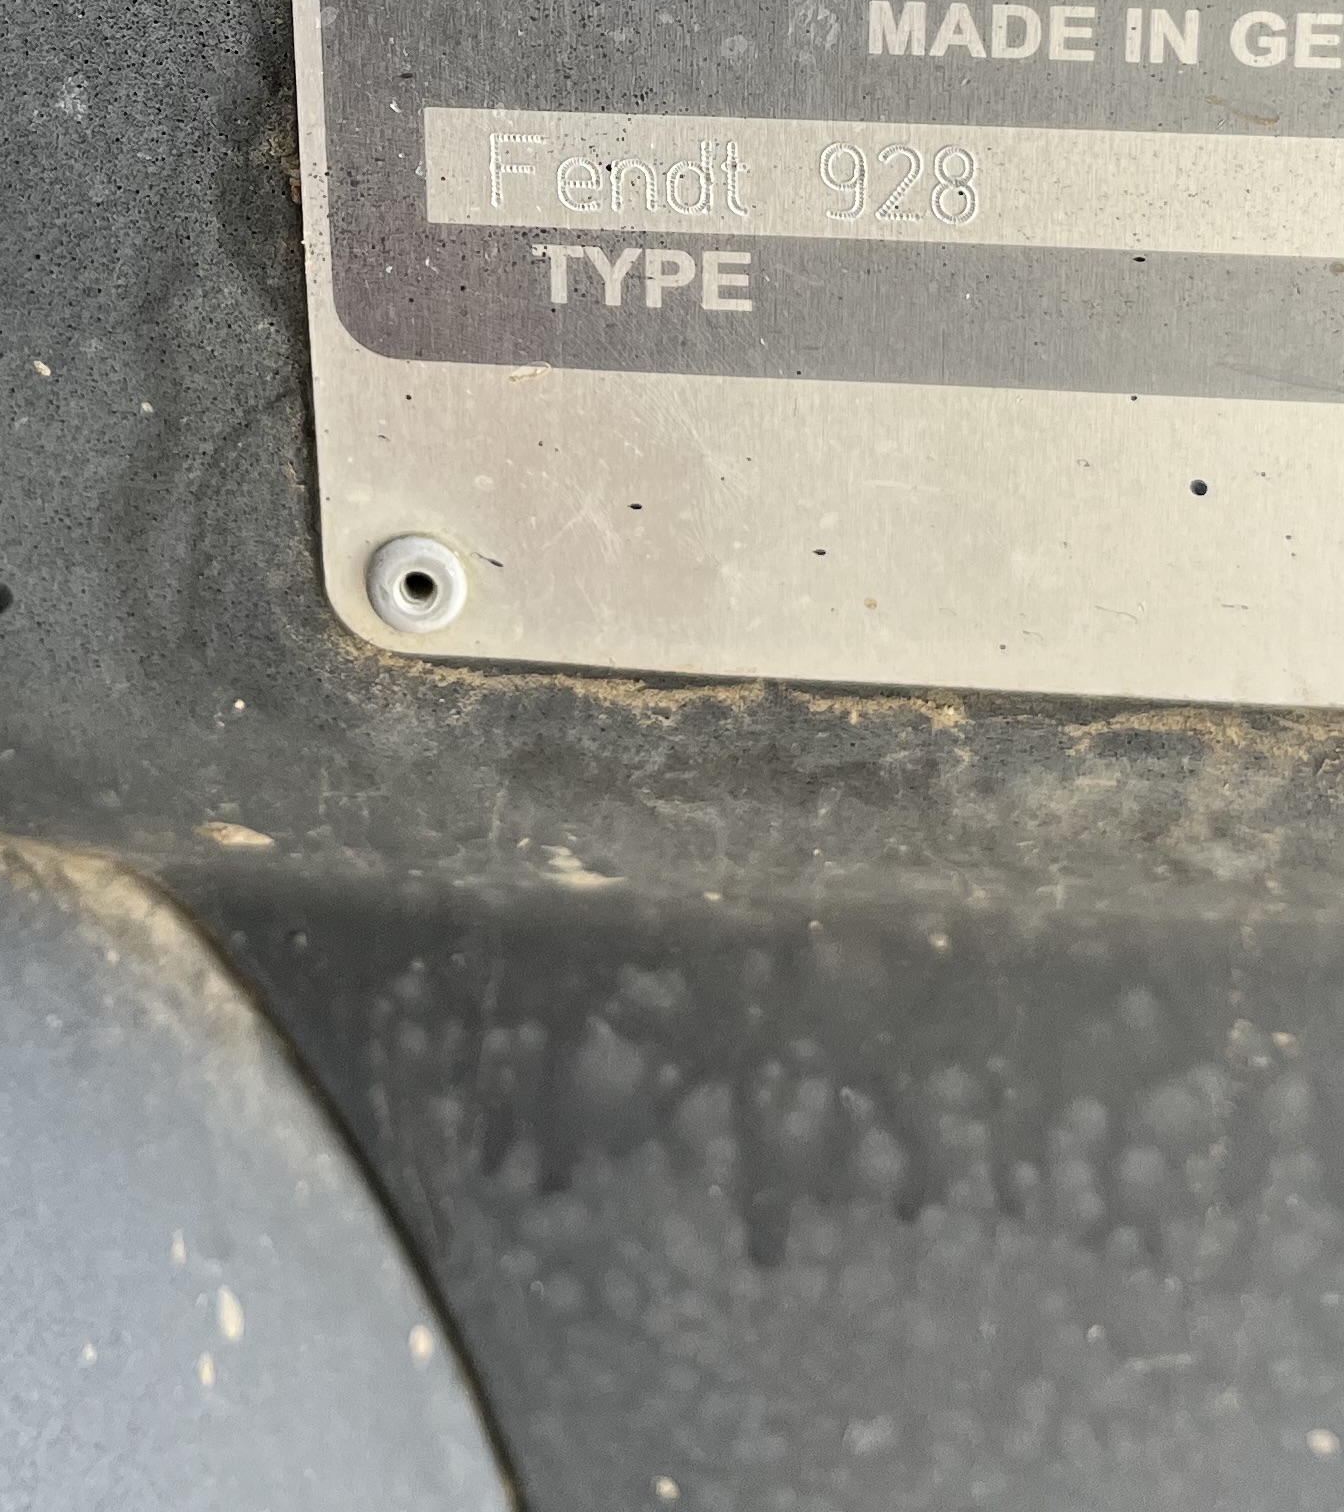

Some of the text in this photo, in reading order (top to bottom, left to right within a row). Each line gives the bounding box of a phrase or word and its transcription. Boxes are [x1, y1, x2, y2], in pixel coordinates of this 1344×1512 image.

[867, 0, 1095, 62] MADE
[1124, 7, 1201, 65] IN
[489, 132, 979, 225] Fendt 928
[532, 243, 753, 312] TYPE
